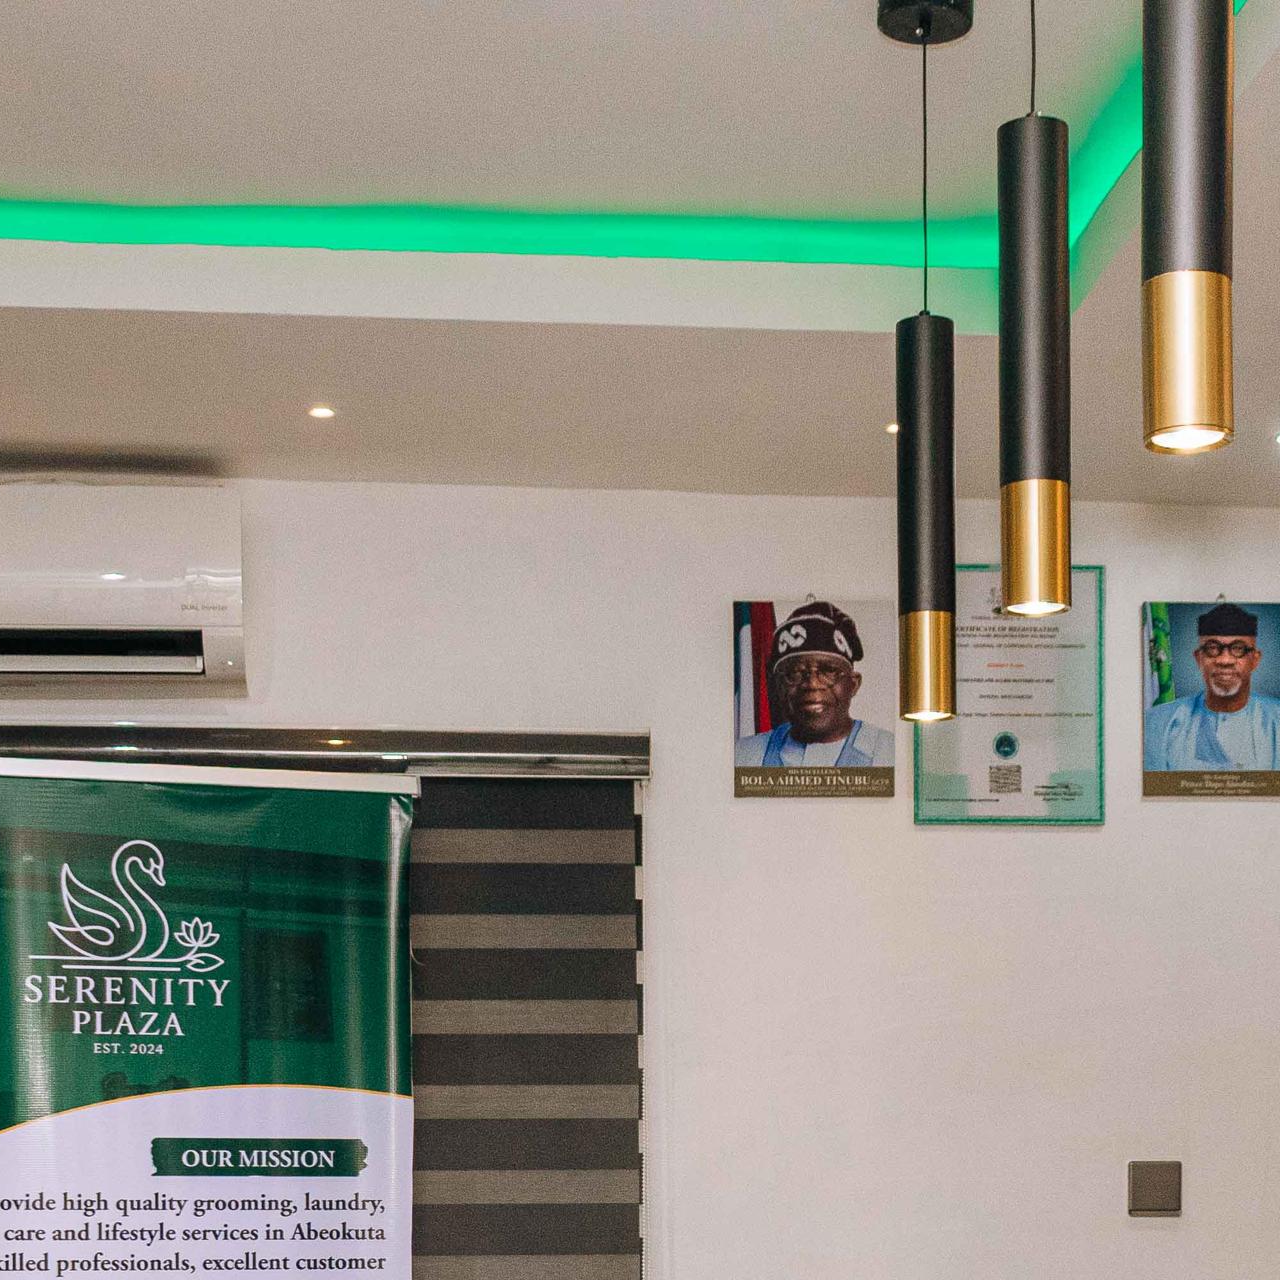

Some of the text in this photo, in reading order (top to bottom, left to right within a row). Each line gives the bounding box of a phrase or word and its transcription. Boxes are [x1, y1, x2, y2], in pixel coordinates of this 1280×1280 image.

[741, 776, 774, 785] BOLA
[777, 776, 821, 785] AHMED
[824, 776, 870, 785] TINUBU
[23, 975, 231, 1007] SERENITY
[72, 1011, 185, 1036] PLAZA
[92, 1042, 166, 1056] EST. 2024
[181, 1149, 335, 1168] OUR MISSION
[62, 1191, 109, 1218] high
[115, 1192, 188, 1217] quality
[193, 1193, 298, 1218] grooming,
[304, 1192, 385, 1217] laundry,
[4, 1229, 46, 1241] care
[52, 1222, 91, 1241] and
[96, 1221, 176, 1247] lifestyle
[182, 1223, 259, 1241] services
[265, 1223, 285, 1241] in
[291, 1221, 386, 1241] Abeokuta
[56, 1252, 196, 1278] professionals,
[202, 1251, 290, 1271] excellent
[295, 1256, 386, 1271] customer
